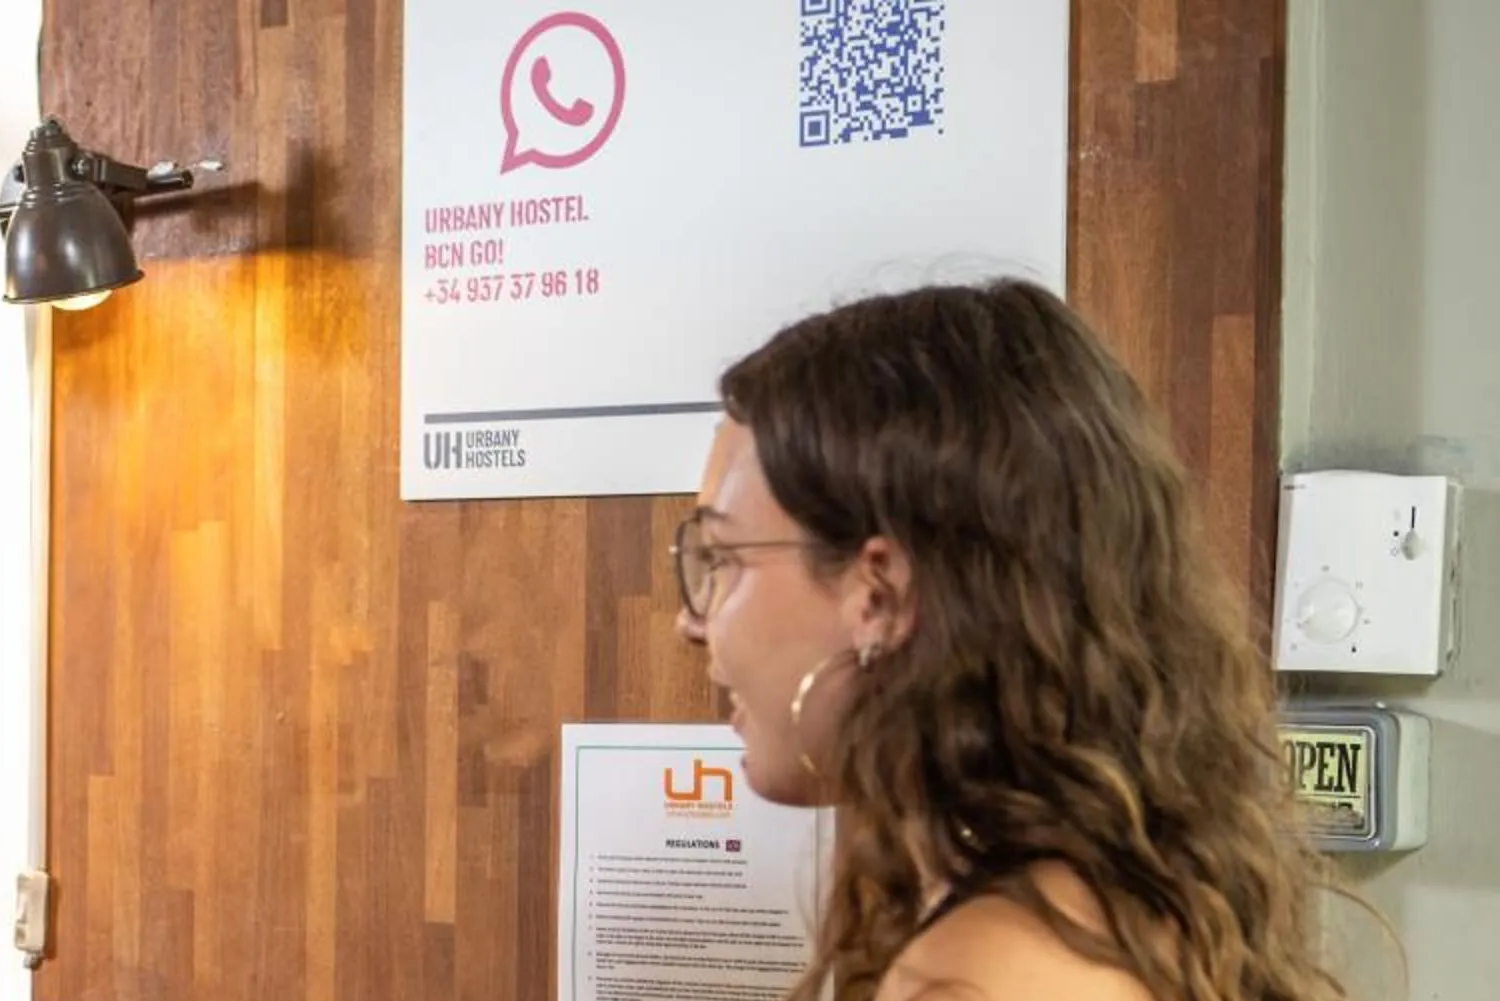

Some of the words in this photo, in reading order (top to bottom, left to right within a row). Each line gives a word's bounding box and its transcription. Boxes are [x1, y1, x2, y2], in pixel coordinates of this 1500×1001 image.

[425, 202, 505, 234] URBANY
[510, 195, 589, 228] HOSTEL
[424, 241, 464, 270] BCN
[469, 238, 505, 266] GO!
[424, 278, 461, 304] +34
[467, 274, 505, 302] 937
[510, 272, 536, 300] 37
[541, 270, 567, 298] 96
[575, 268, 600, 296] 18
[423, 431, 463, 470] UH
[465, 428, 521, 449] URBANY
[465, 448, 526, 469] HOSTELS
